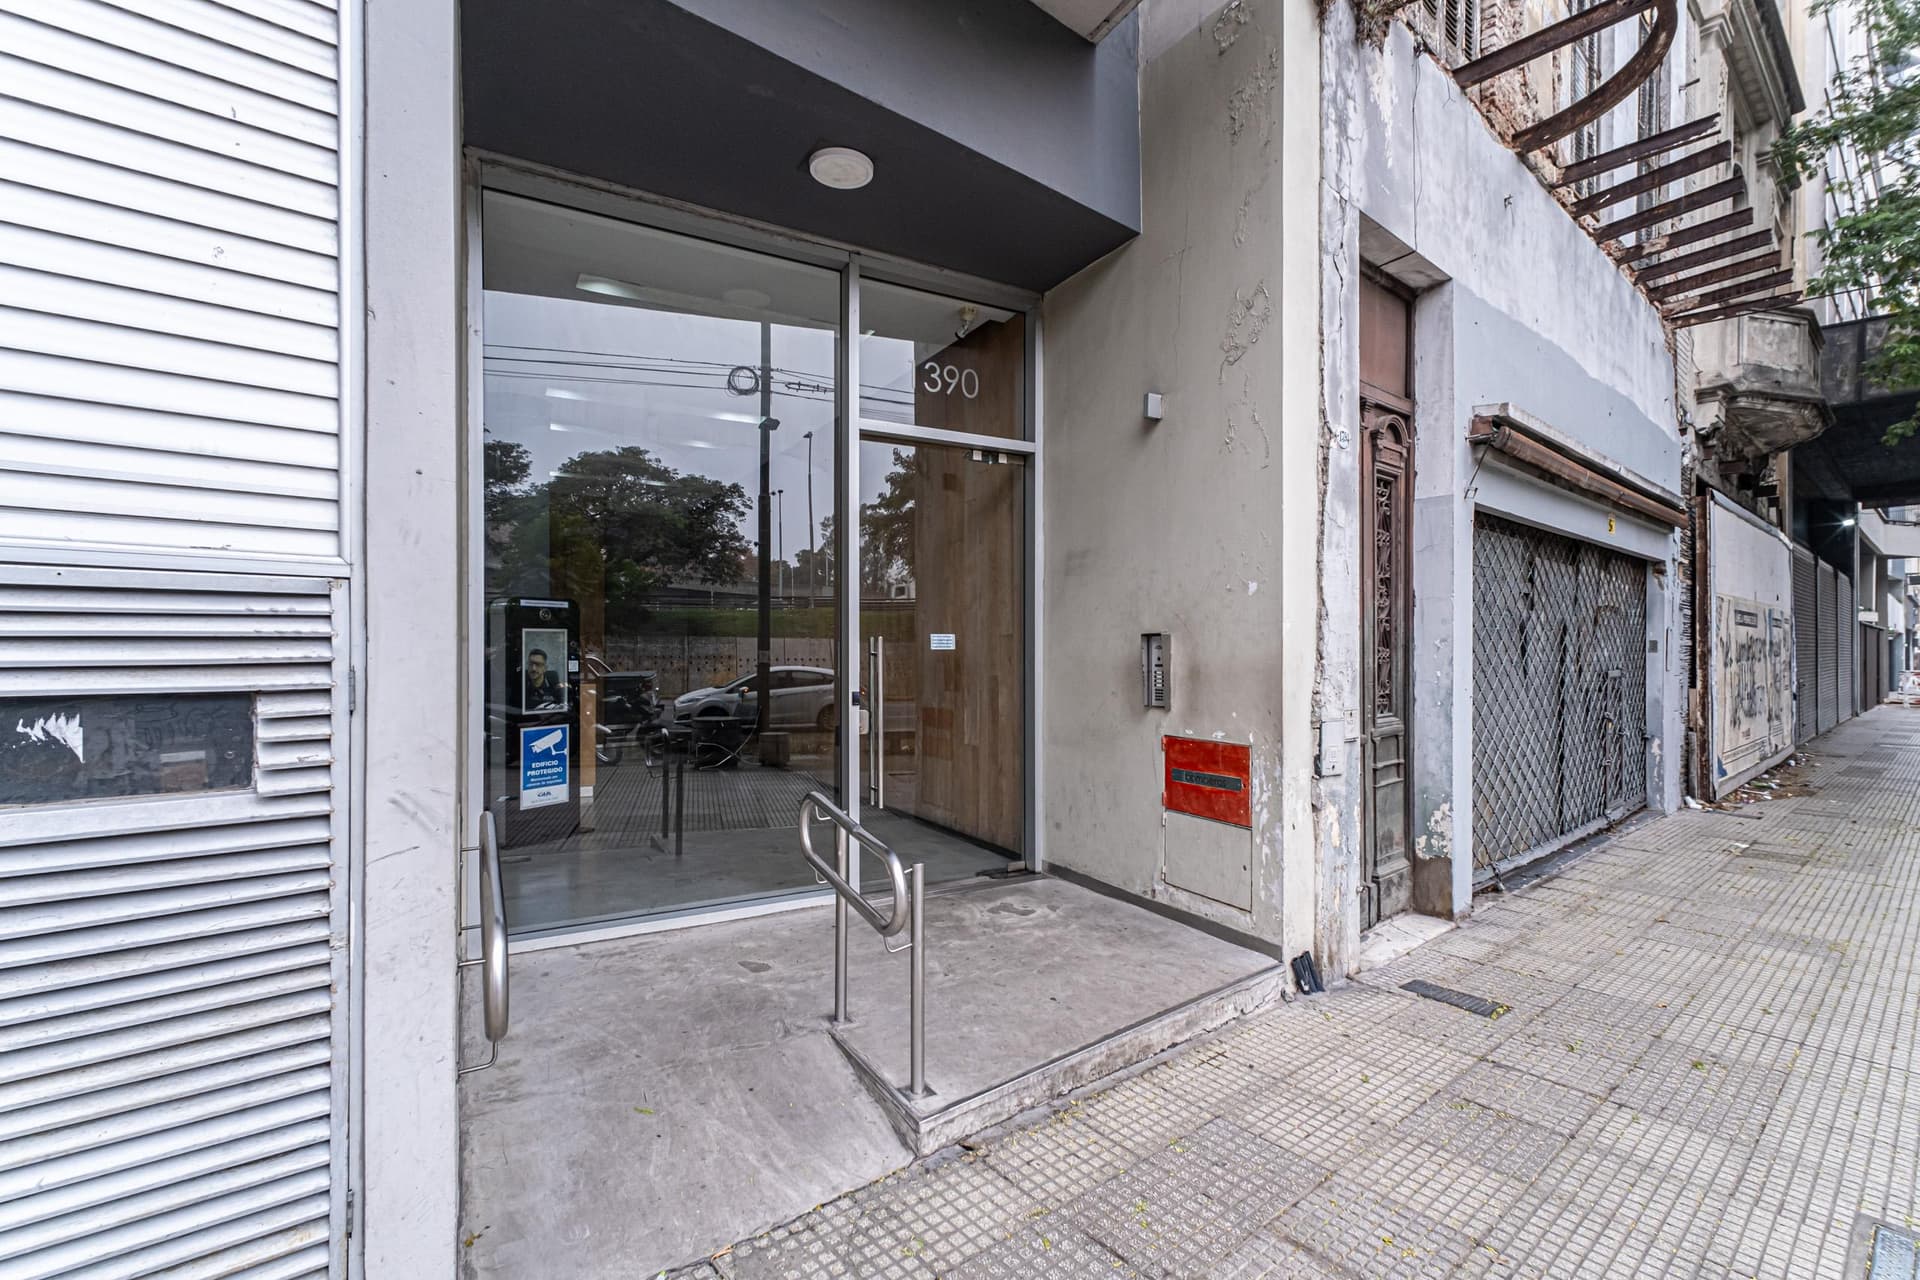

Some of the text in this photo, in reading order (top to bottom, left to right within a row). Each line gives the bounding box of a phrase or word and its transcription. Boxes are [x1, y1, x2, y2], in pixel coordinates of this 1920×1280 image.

[924, 362, 979, 399] 390
[531, 759, 559, 769] EDIFICIO
[527, 767, 563, 777] PROTEGIDO
